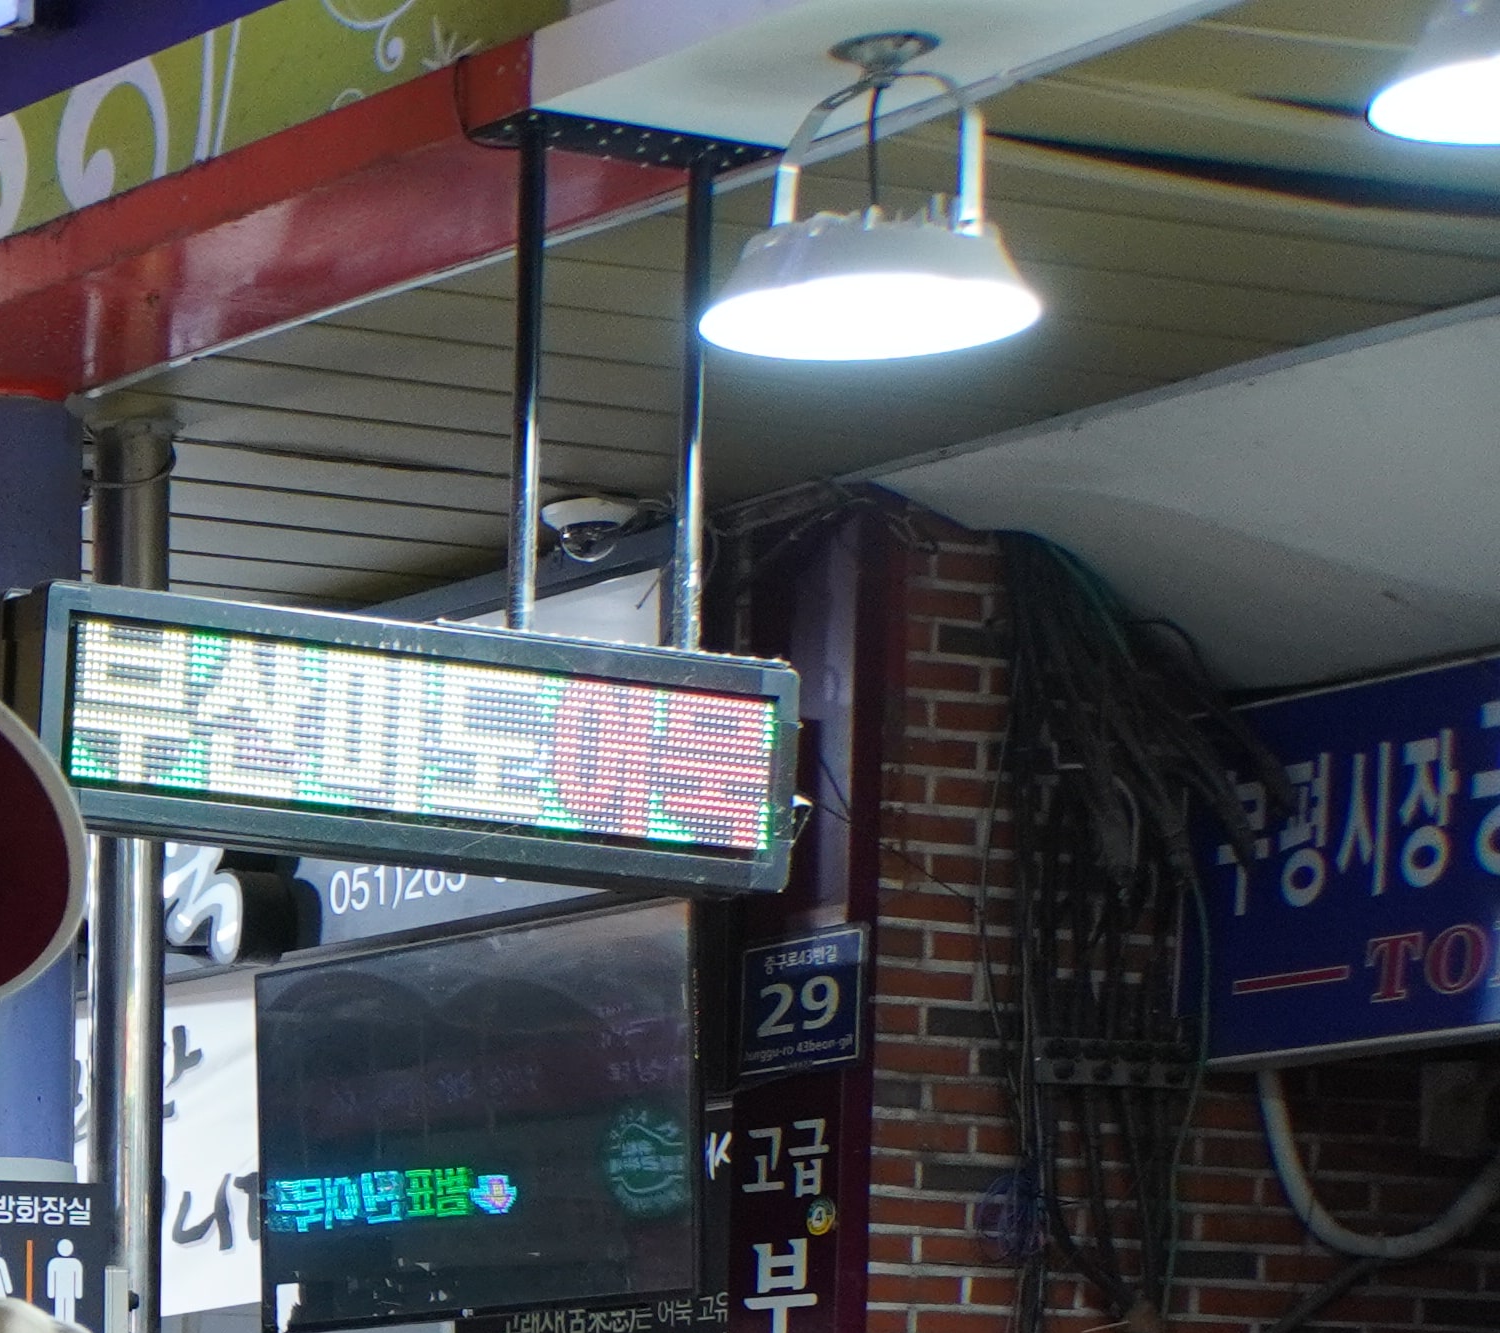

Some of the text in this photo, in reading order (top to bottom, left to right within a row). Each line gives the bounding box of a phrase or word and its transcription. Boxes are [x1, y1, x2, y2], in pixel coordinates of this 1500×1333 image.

[1364, 922, 1500, 1004] TO
[756, 974, 840, 1038] 29
[741, 1117, 830, 1199] 고급
